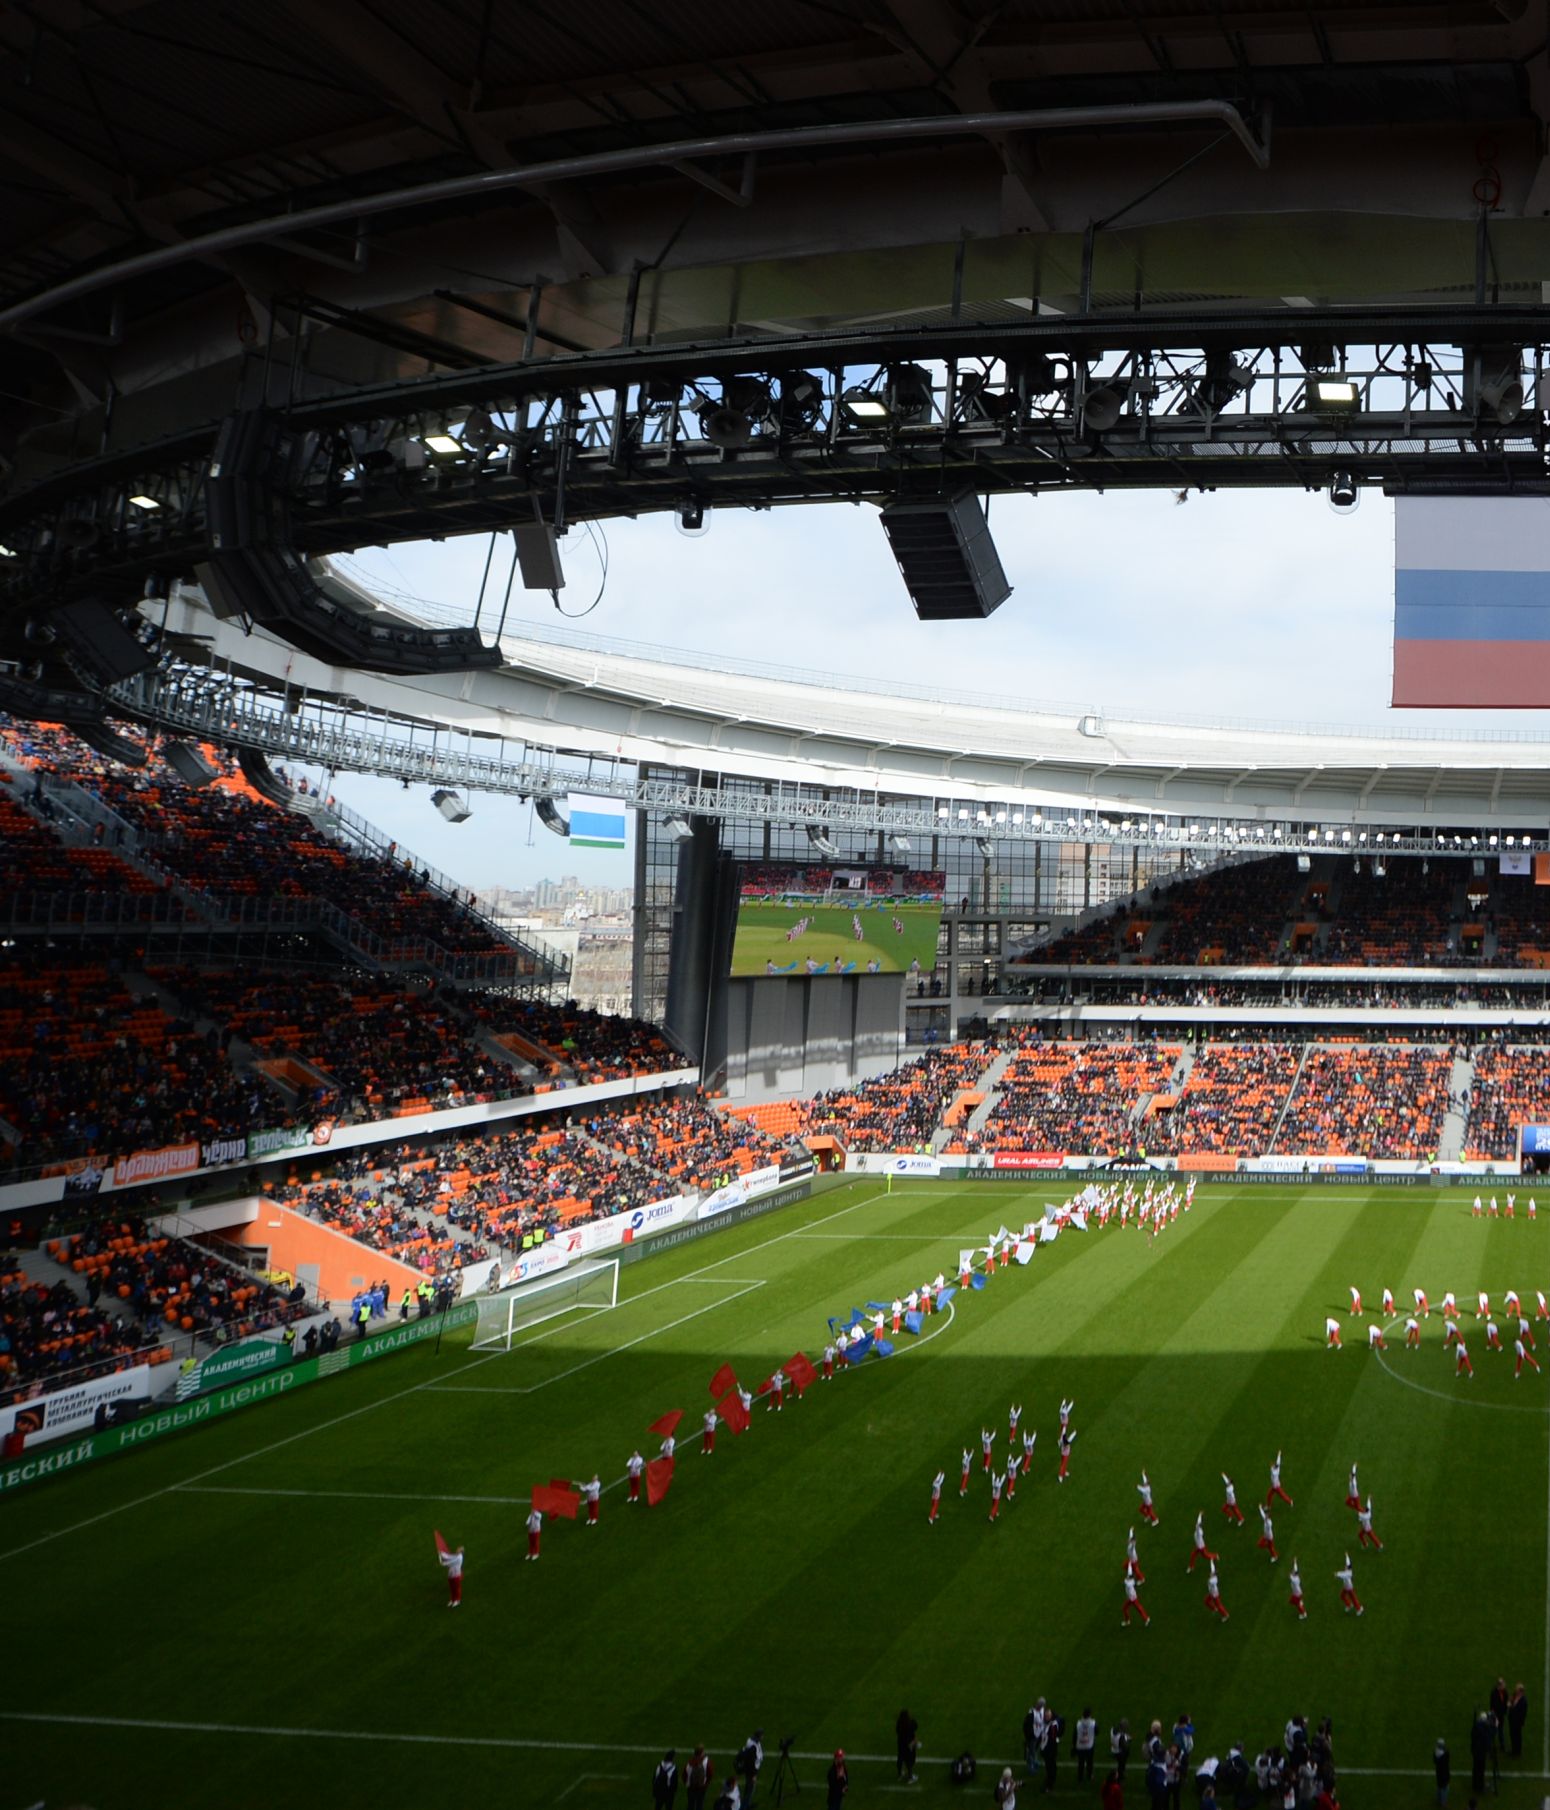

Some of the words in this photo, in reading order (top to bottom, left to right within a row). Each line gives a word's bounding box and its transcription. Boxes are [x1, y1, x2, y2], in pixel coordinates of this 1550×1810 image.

[966, 1169, 1067, 1181] АКАДЕМИЧЕСКИЙ
[1211, 1173, 1313, 1184] АКАДЕМИЧЕСКИЙ
[650, 1212, 733, 1252] АКАДЕМИЧЕСКИЙ
[203, 1345, 277, 1377] АКАДЕМИЧЕСКИЙ
